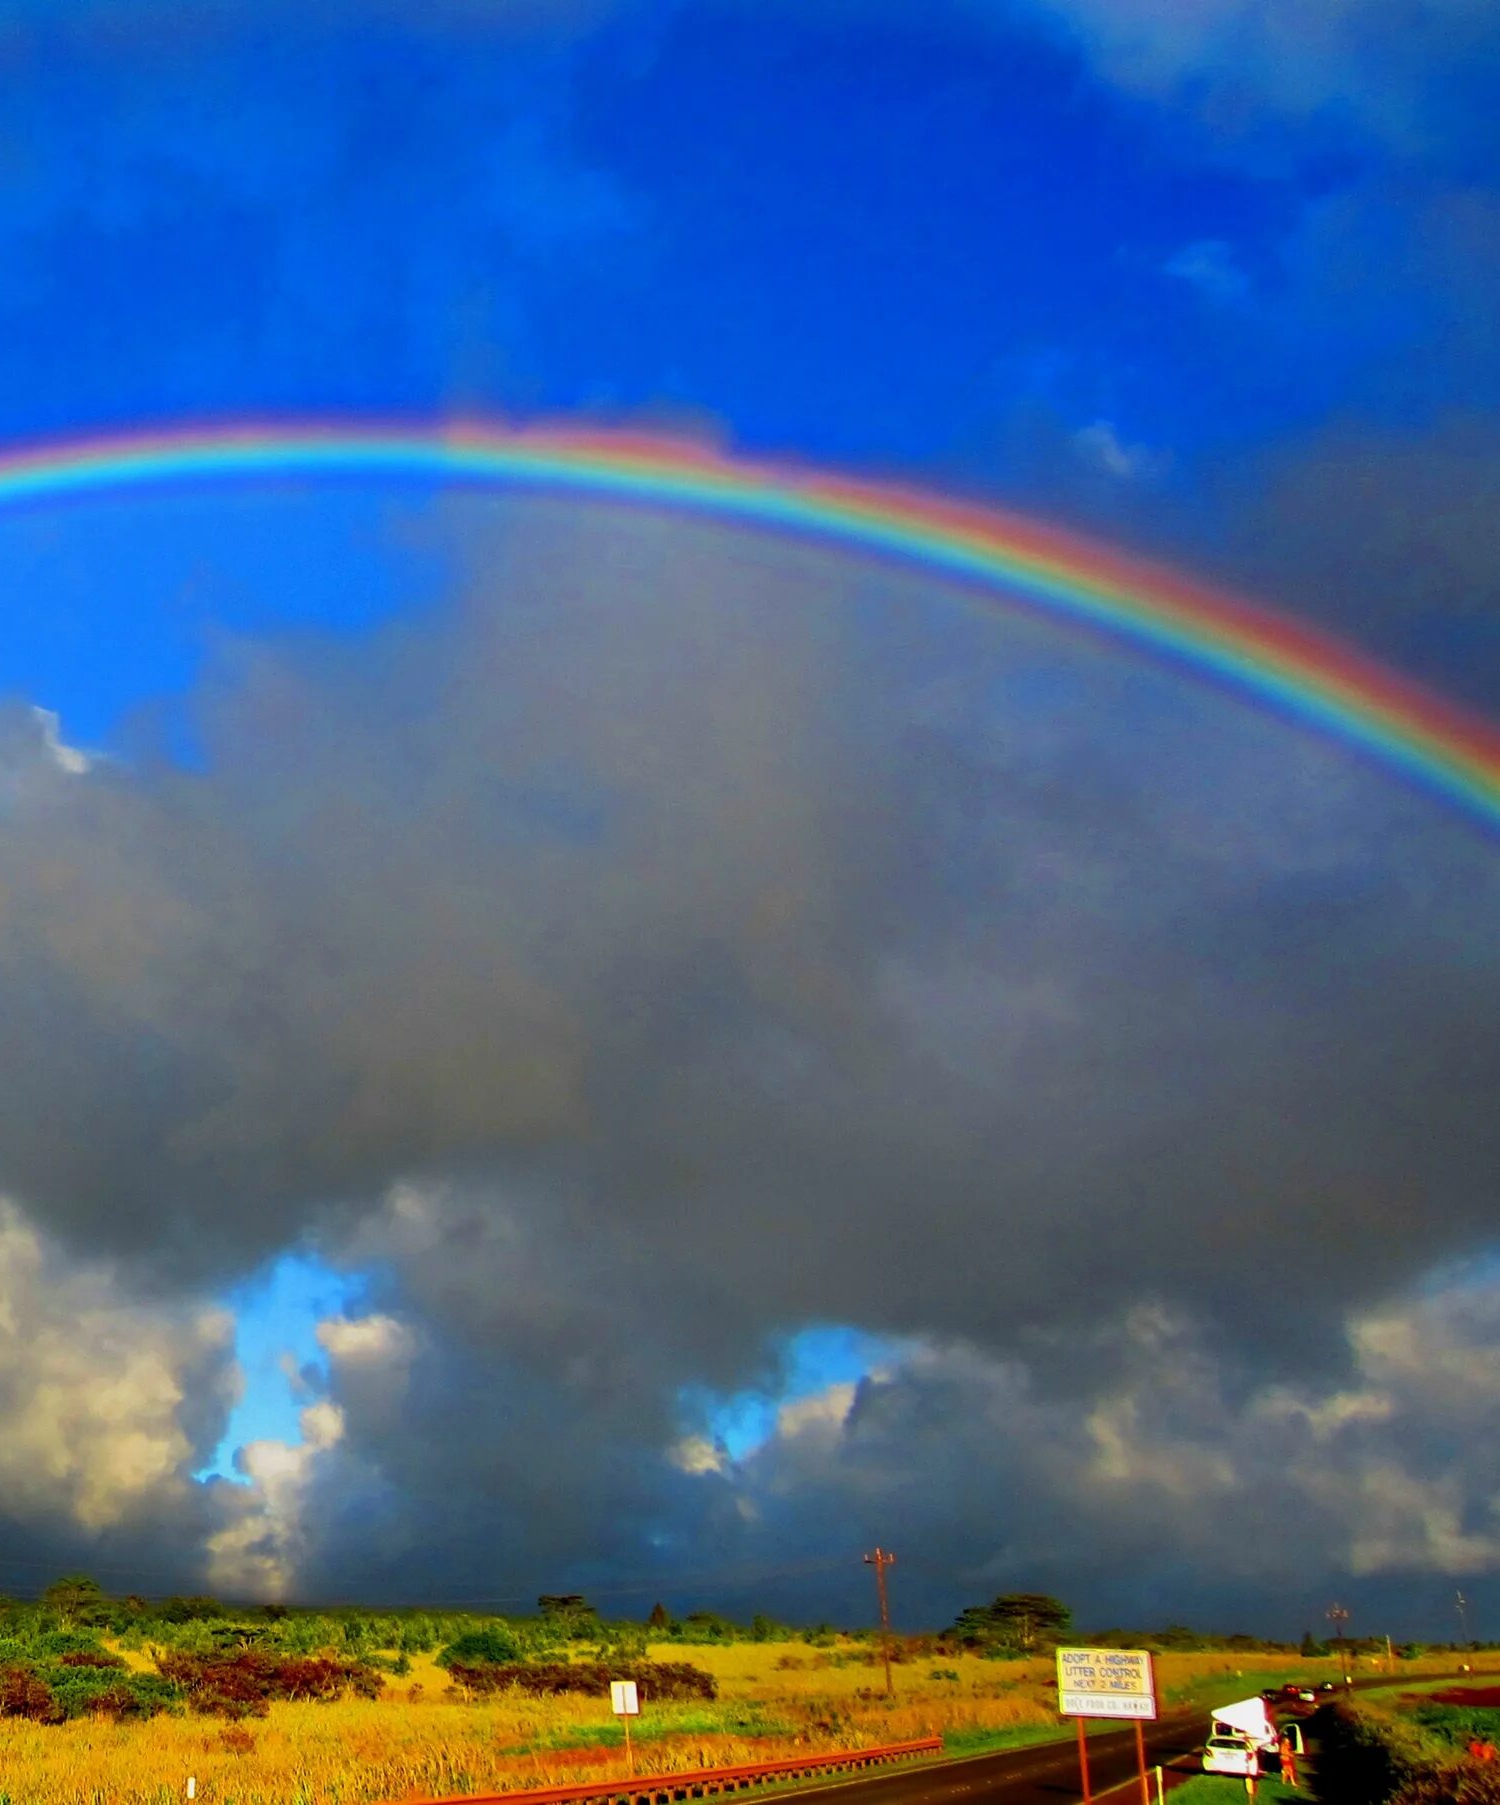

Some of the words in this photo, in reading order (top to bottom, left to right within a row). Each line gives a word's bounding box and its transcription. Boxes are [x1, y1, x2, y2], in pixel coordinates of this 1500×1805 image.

[1063, 1653, 1090, 1664] ADOPT
[1095, 1655, 1101, 1664] A
[1105, 1654, 1144, 1665] HIGHWAY
[1099, 1667, 1142, 1679] CONTROL
[1073, 1680, 1094, 1689] NEXT
[1110, 1680, 1138, 1690] MILES
